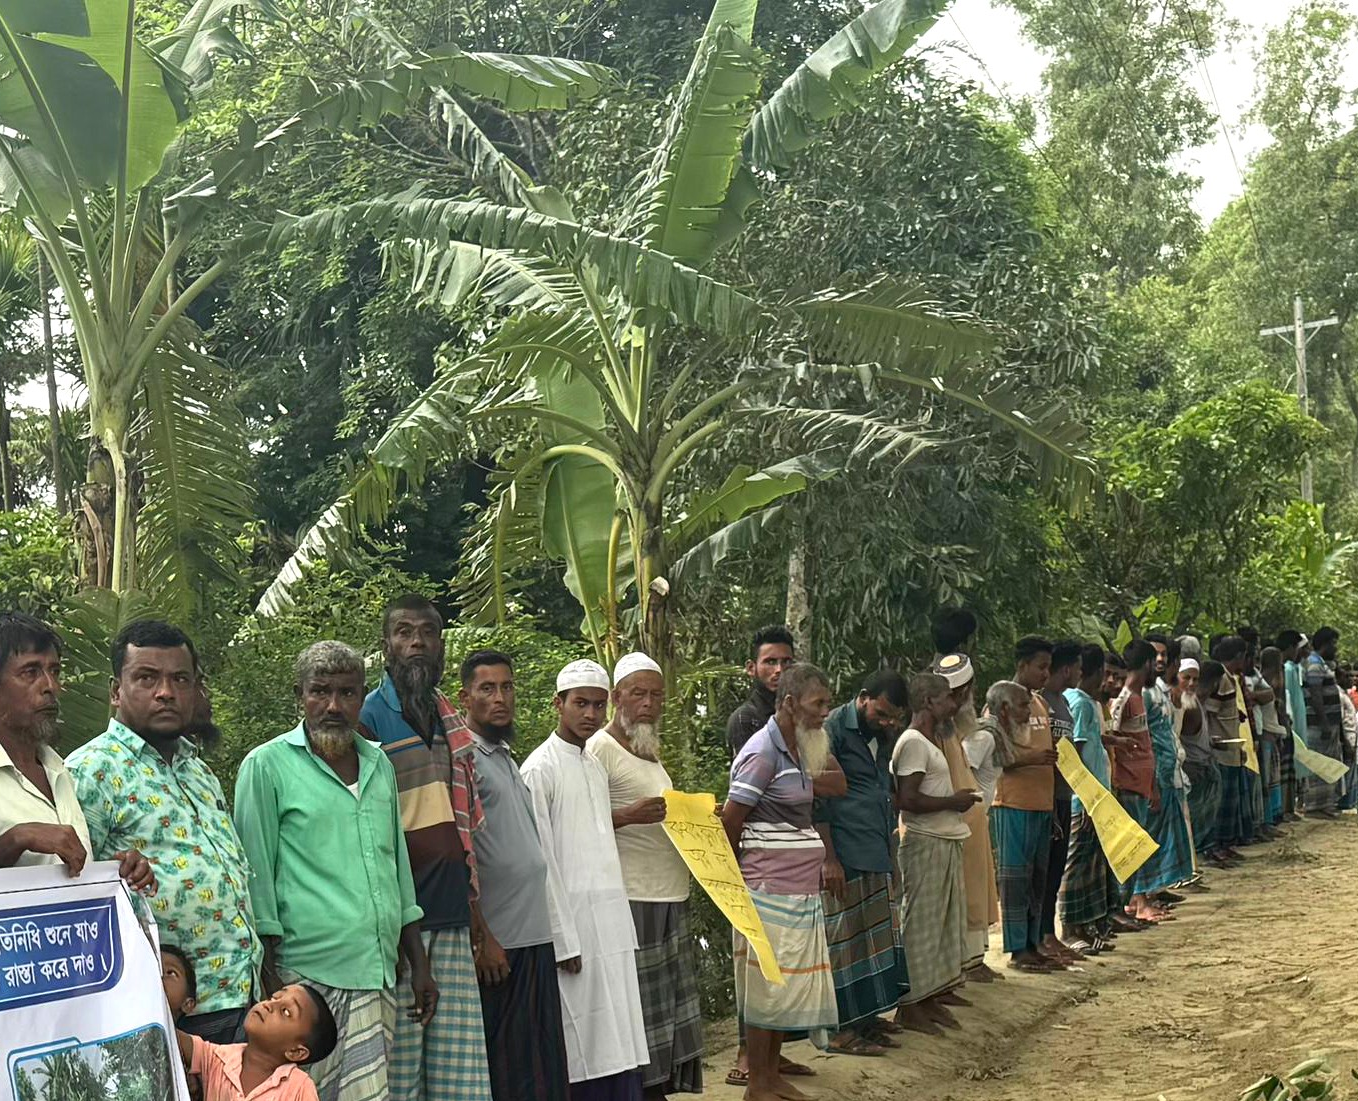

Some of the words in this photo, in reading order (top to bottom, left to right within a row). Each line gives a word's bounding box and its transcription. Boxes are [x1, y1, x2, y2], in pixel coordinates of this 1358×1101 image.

[44, 924, 72, 946] শুনে
[73, 920, 99, 943] যাও
[2, 960, 36, 988] রাস্তা
[38, 957, 70, 981] করে
[70, 953, 94, 976] দাও
